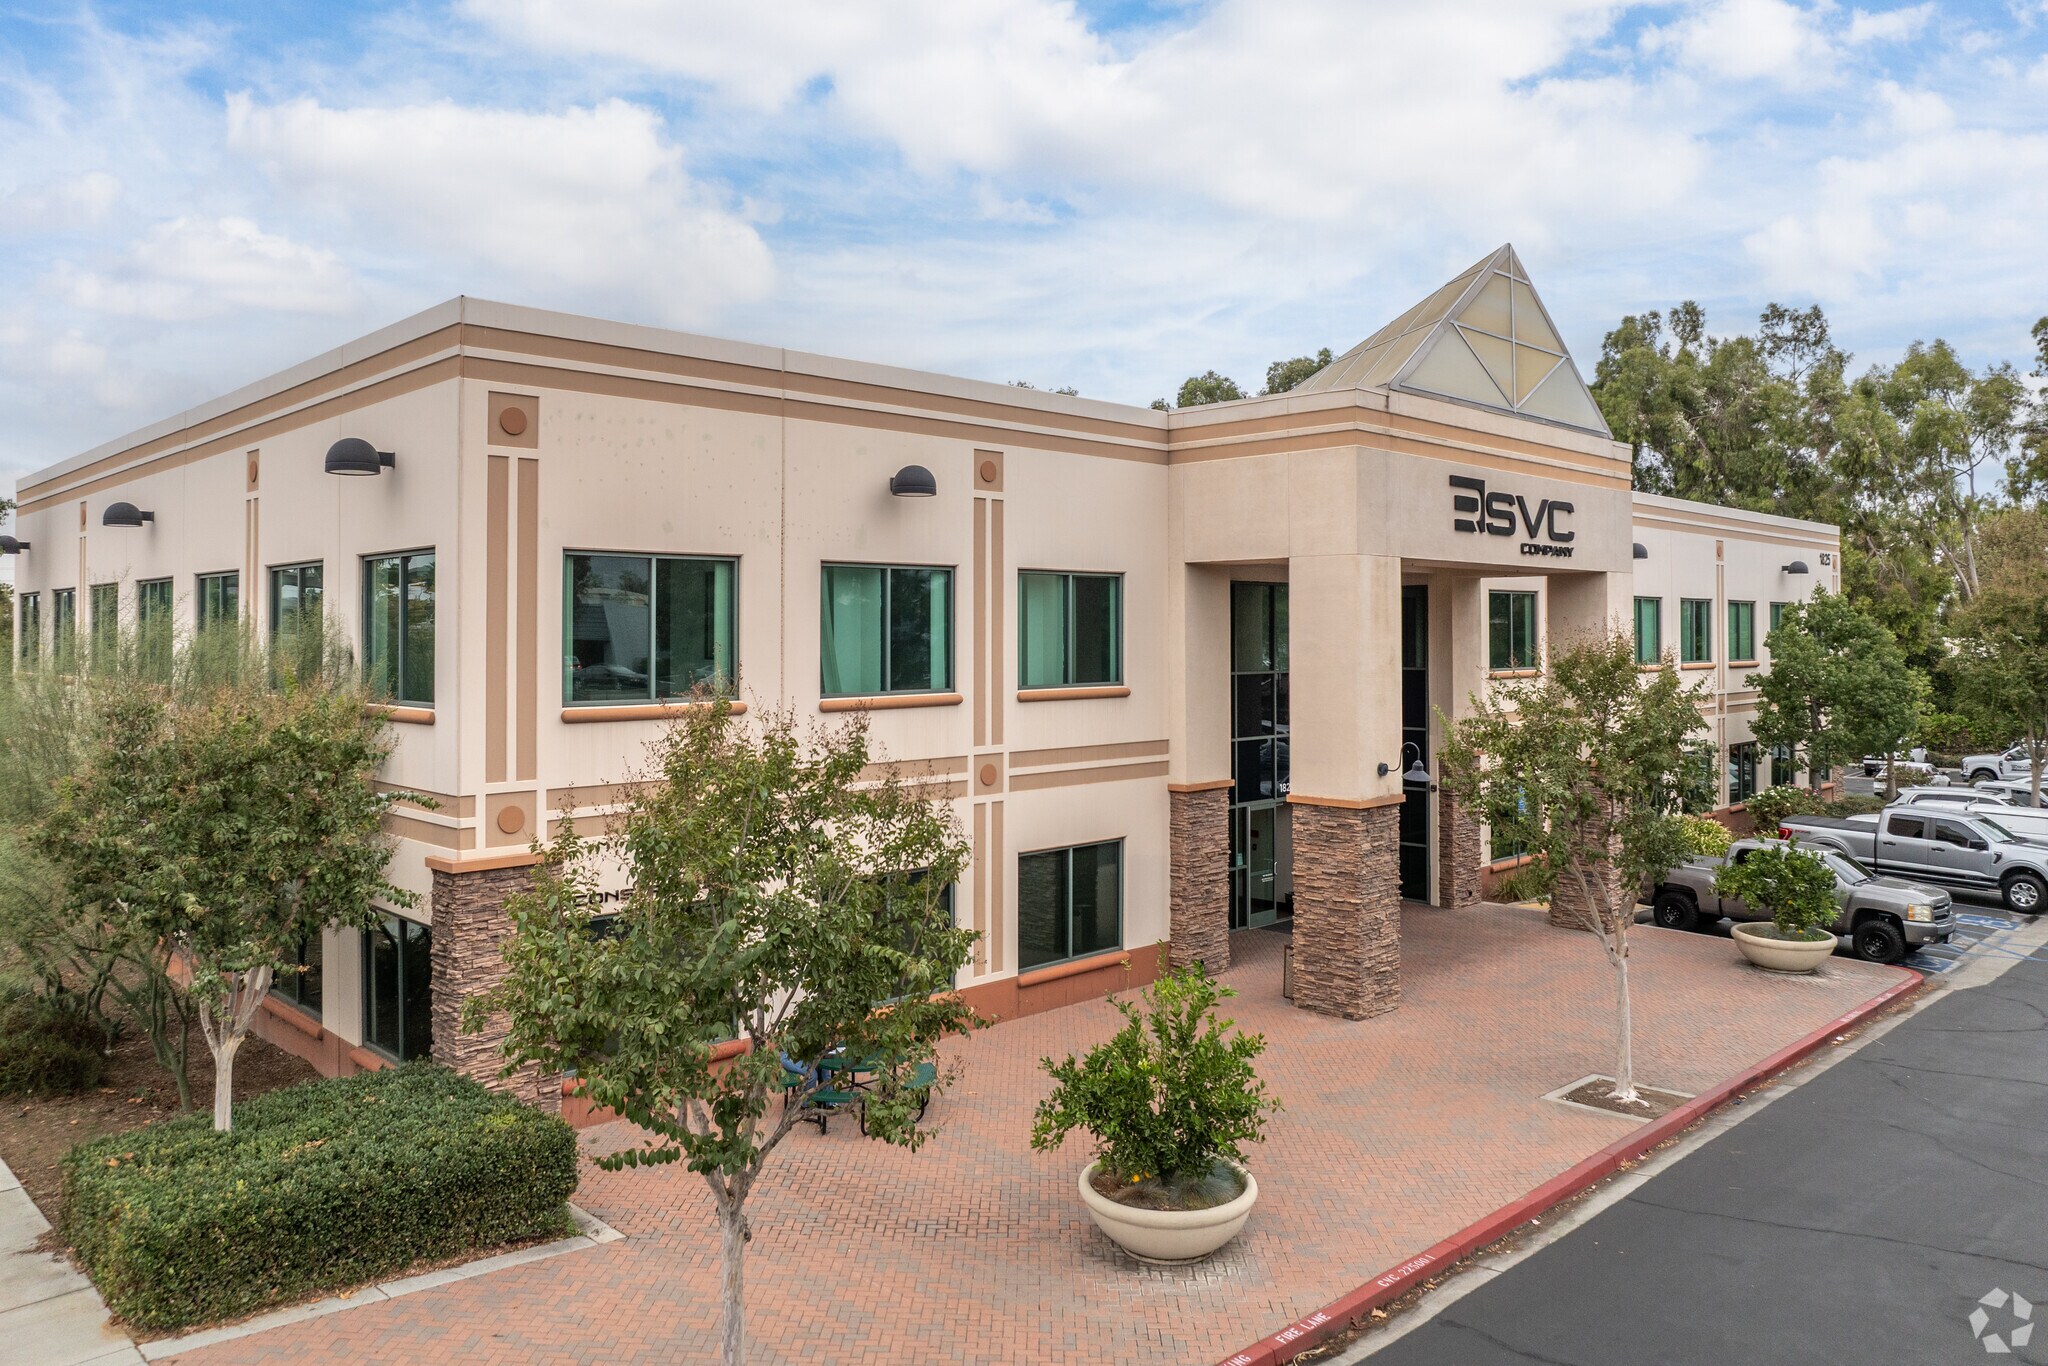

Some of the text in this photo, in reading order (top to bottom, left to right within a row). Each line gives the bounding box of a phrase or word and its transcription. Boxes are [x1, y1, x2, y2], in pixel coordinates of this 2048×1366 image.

[1520, 543, 1575, 557] COMPANY
[1275, 1312, 1331, 1344] FIRE LANE
